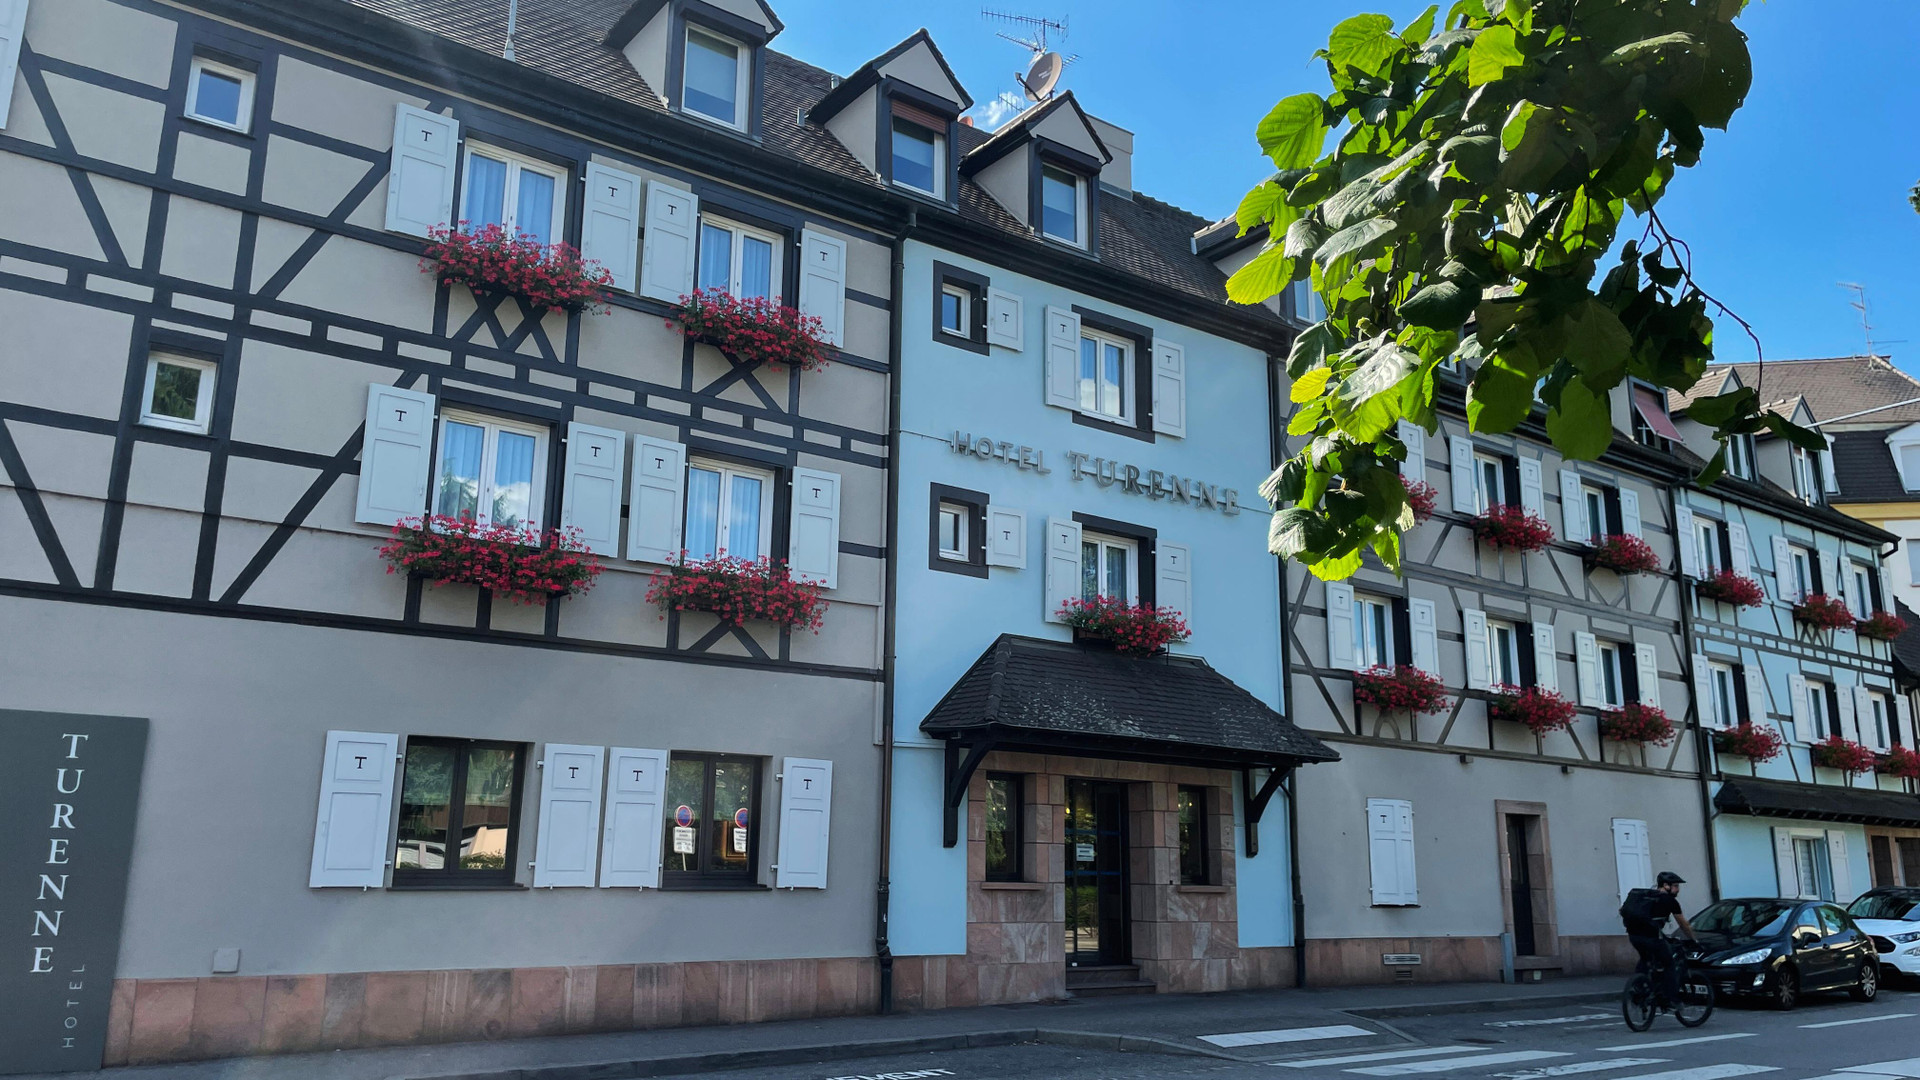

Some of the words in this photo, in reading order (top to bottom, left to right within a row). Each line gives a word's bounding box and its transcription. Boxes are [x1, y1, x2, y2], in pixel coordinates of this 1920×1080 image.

[421, 129, 432, 141] T
[608, 186, 617, 197] T
[668, 204, 677, 214] T
[819, 251, 828, 262] T
[395, 410, 406, 421] T
[591, 446, 601, 457] T
[654, 458, 664, 469] T
[951, 430, 1051, 474] HOTEL
[1067, 450, 1240, 515] TURENNE
[812, 488, 821, 499] T
[355, 757, 367, 769] T
[568, 767, 578, 778] T
[632, 770, 642, 781] T
[803, 779, 812, 789] T
[29, 733, 89, 973] TURENNE
[61, 963, 86, 1048] HOTEL
